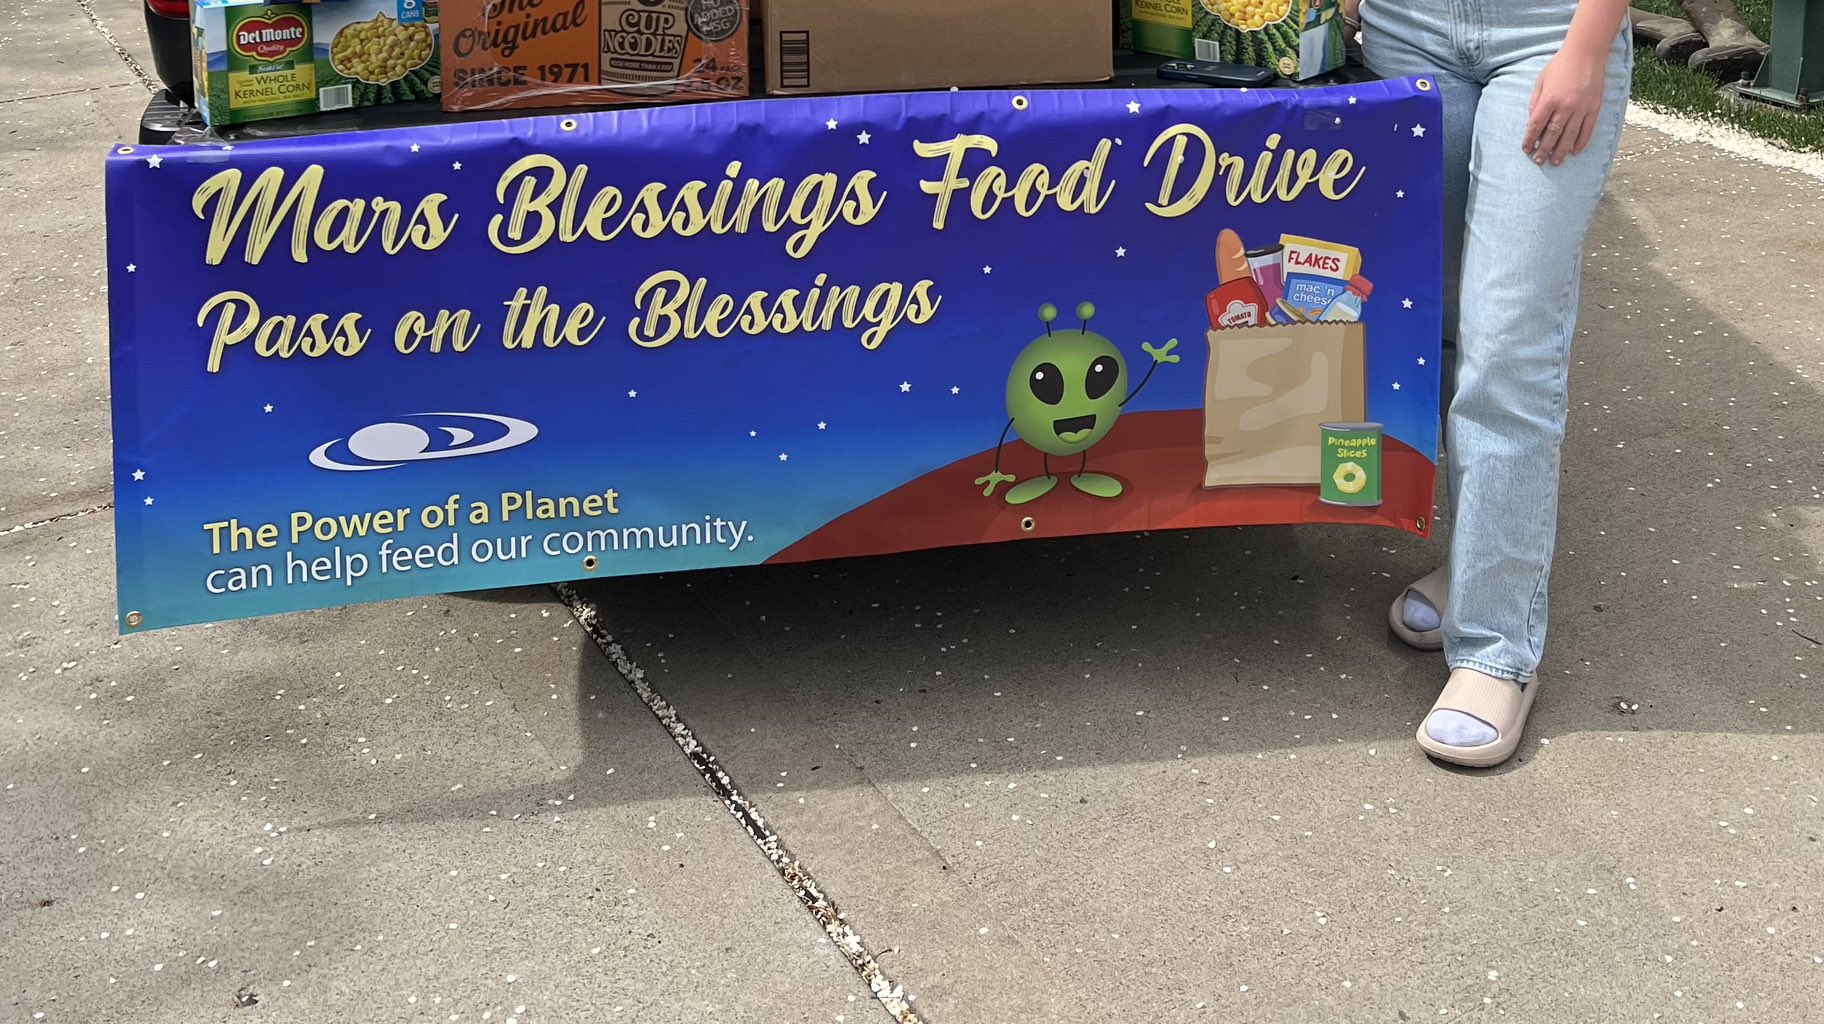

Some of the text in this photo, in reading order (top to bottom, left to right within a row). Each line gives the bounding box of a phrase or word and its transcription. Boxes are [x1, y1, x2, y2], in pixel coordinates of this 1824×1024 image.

[401, 10, 420, 19] CANS
[694, 7, 735, 26] ADDED
[1164, 3, 1188, 16] CORN
[453, 0, 588, 58] Original
[619, 9, 676, 35] CUP
[700, 19, 731, 34] MSG
[239, 26, 303, 45] Del Monte
[602, 29, 683, 59] NOODLES
[257, 43, 285, 54] Quality
[255, 73, 297, 85] WHOLE
[453, 62, 590, 88] SINCE 1971
[234, 82, 311, 100] KERNEL CORN
[191, 123, 1366, 266] Mars Blessings Food Drive
[1287, 250, 1341, 273] FLAKES
[1296, 283, 1335, 297] mac 'n
[196, 269, 942, 373] Pass on the Blessings
[1227, 311, 1252, 325] TOMATO
[1328, 436, 1377, 447] Pineapple
[1337, 447, 1368, 459] Slices
[203, 488, 619, 555] The Power of a Planet
[205, 515, 755, 595] can help feed our community.
